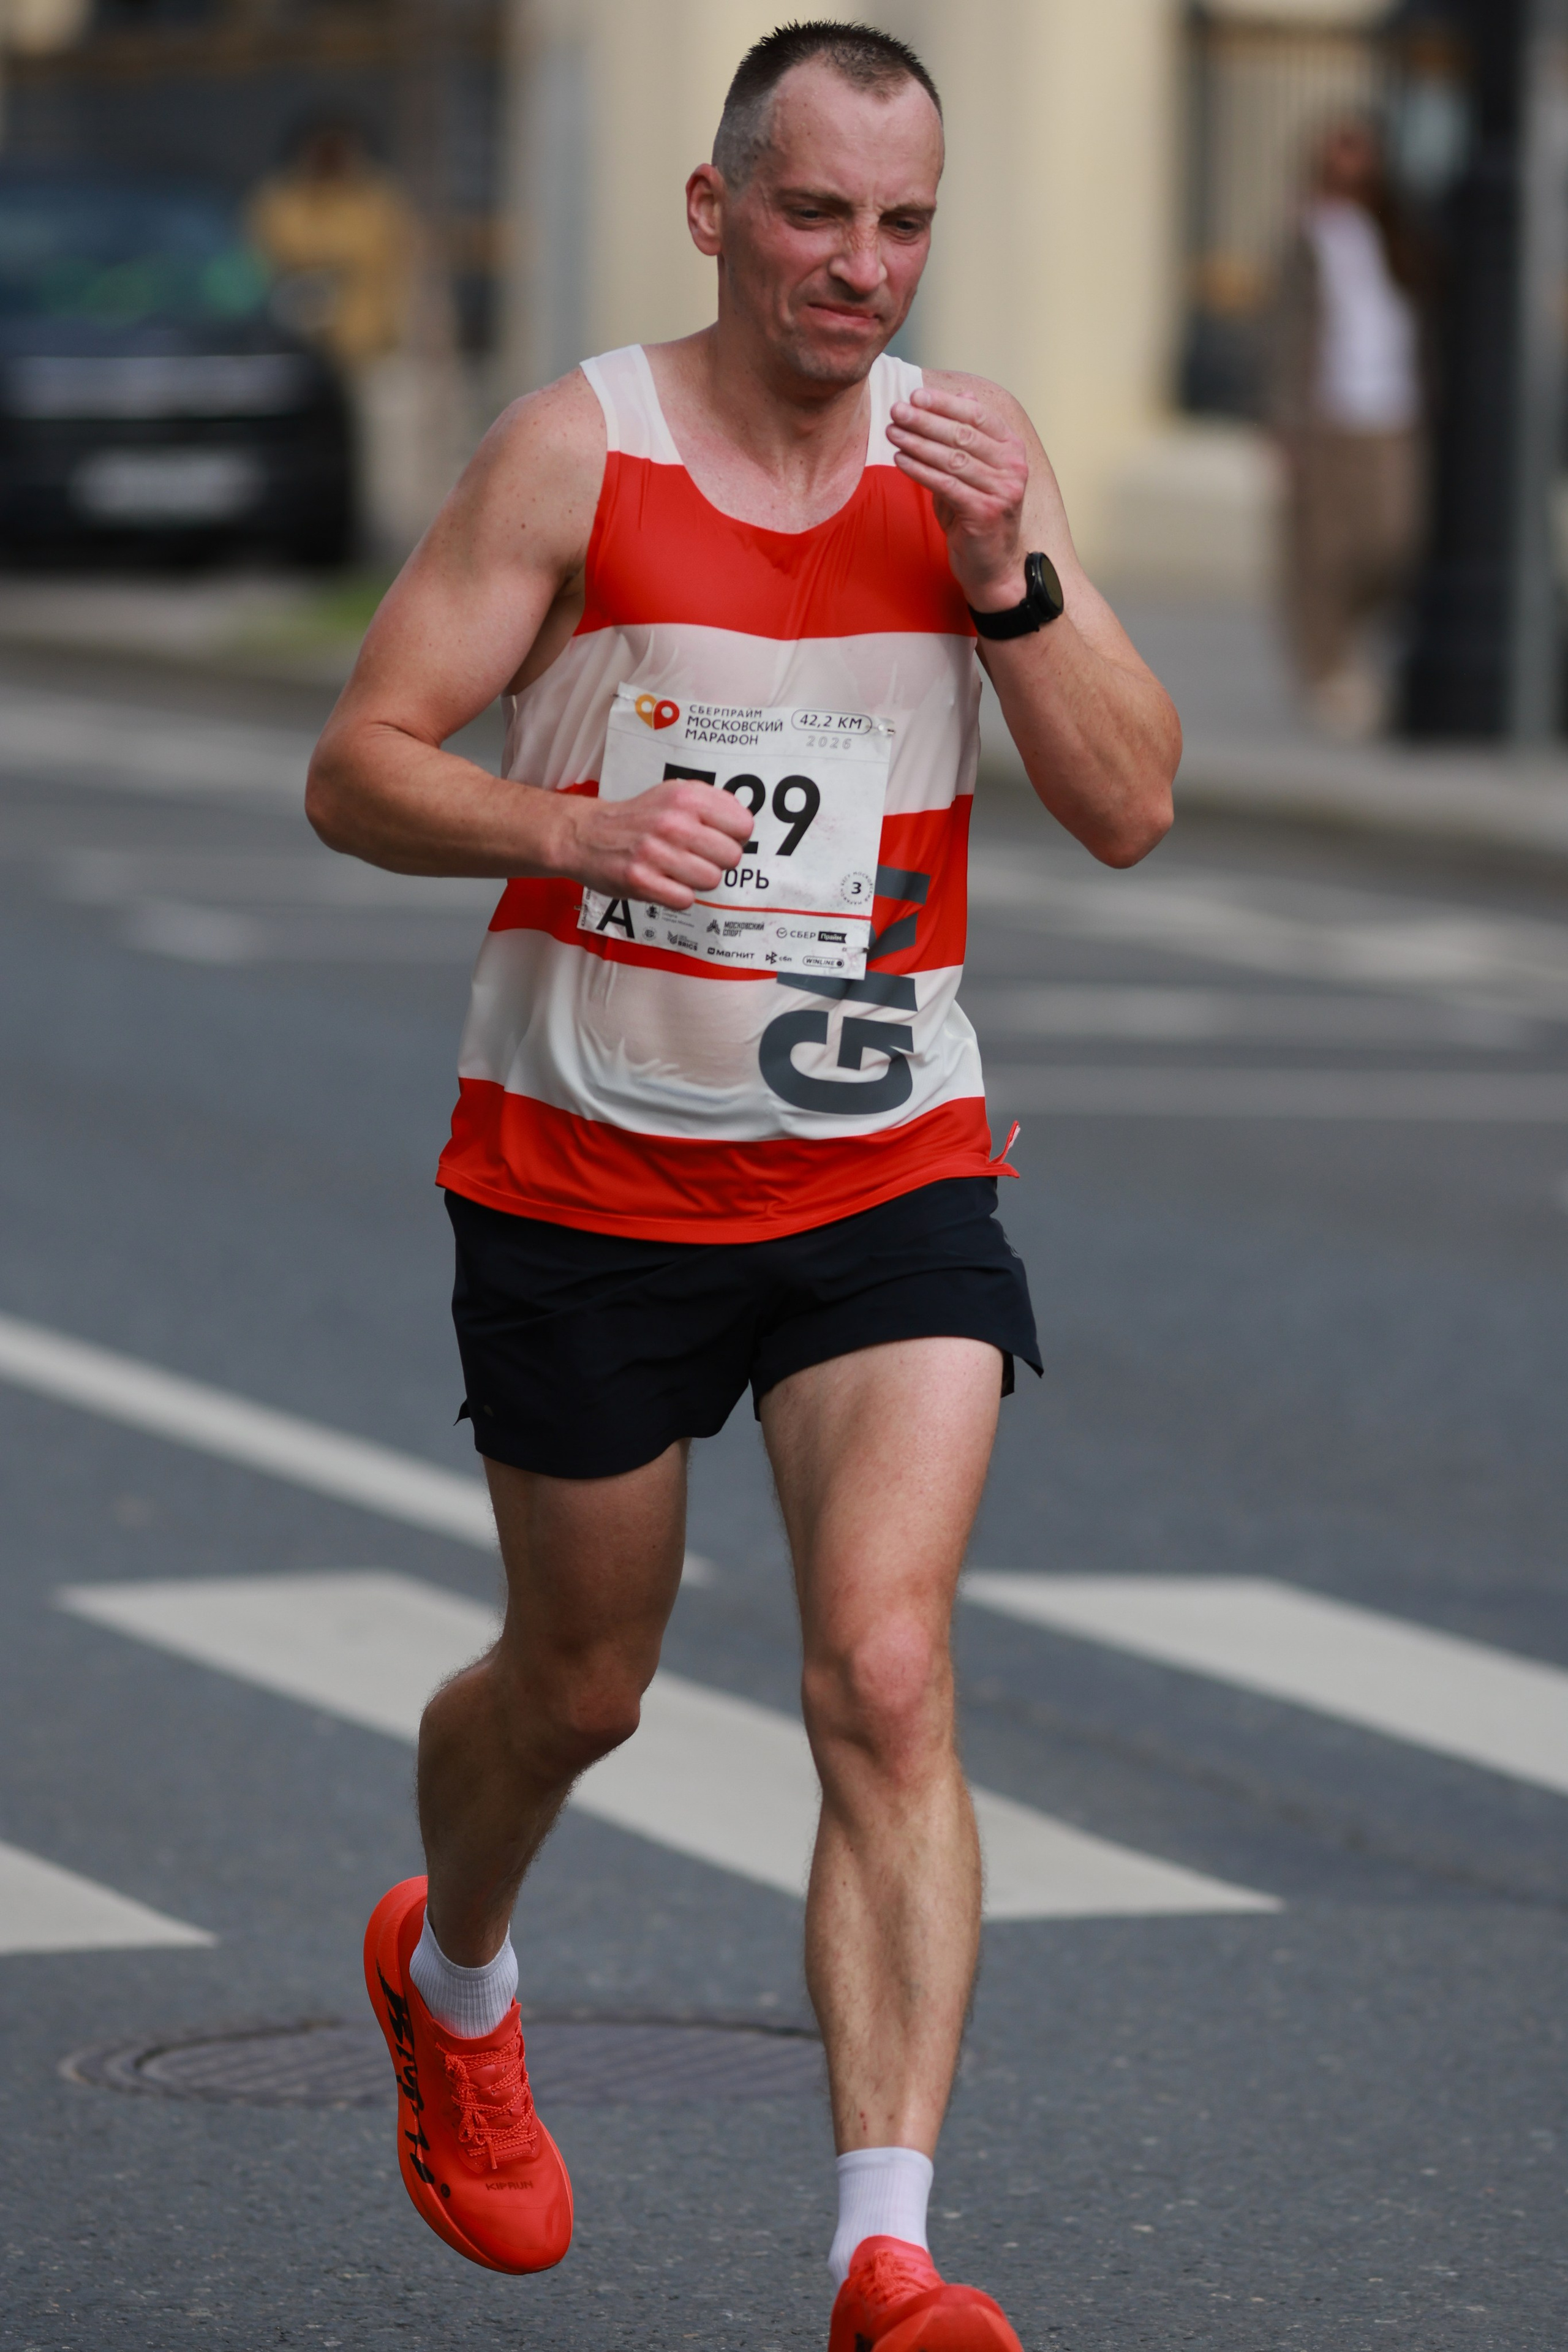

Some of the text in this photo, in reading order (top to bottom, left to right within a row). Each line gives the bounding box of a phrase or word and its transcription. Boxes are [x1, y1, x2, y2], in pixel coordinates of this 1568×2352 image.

[690, 704, 762, 718] СБЕРПРАЙМ
[687, 715, 783, 732] МОСКОВСКИЙ
[800, 714, 832, 728] 42,2
[685, 729, 758, 745] МАРАФОН
[806, 735, 851, 750] 2026
[663, 762, 820, 857] 29
[725, 869, 769, 889] ОРЬ
[851, 881, 862, 894] 3
[724, 921, 764, 930] МОСКОВСКИЙ
[723, 929, 742, 937] СПОРТ
[790, 930, 816, 939] СБЕР
[677, 941, 698, 951] BRICS
[485, 2180, 533, 2191] KIPRUN
